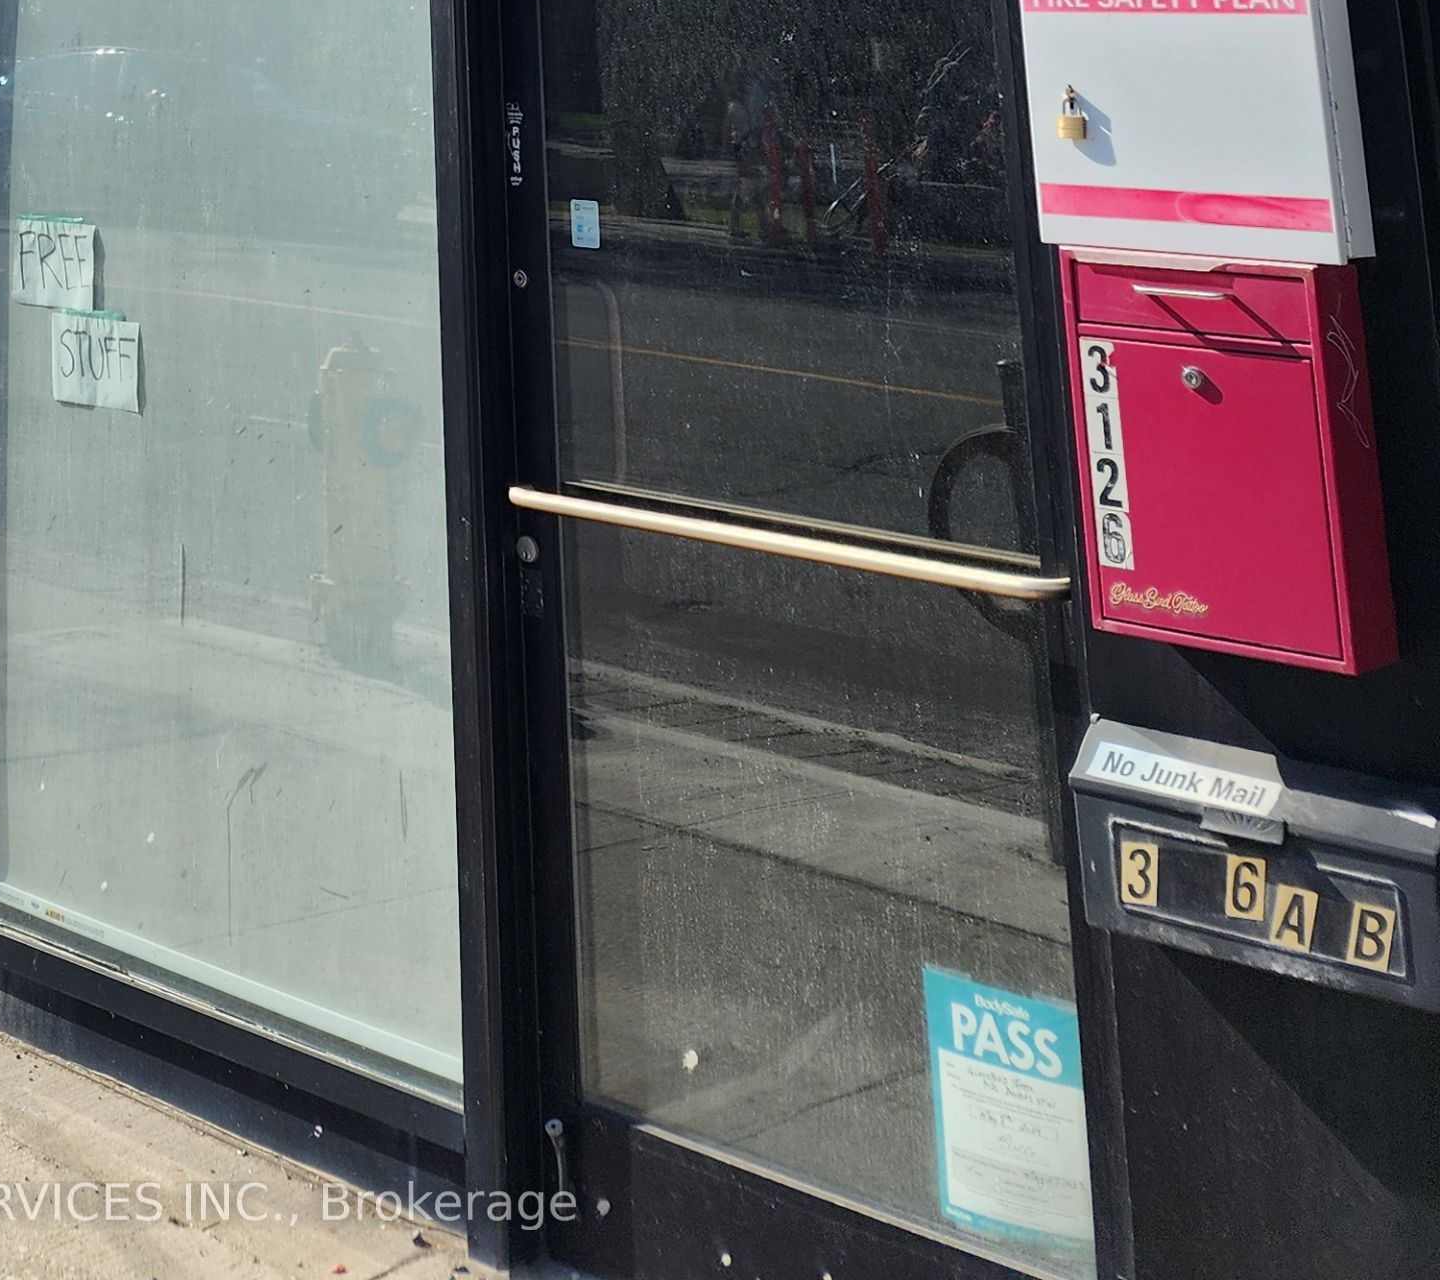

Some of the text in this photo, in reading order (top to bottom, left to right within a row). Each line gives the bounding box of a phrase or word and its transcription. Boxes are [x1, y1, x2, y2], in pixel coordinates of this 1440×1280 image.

[511, 126, 522, 174] PUSH
[18, 230, 92, 290] FREE
[60, 328, 136, 383] STUFF
[1088, 344, 1126, 564] 3126
[1102, 751, 1267, 808] No Junk Mail
[1128, 848, 1152, 900] 3
[950, 1001, 1063, 1079] PASS
